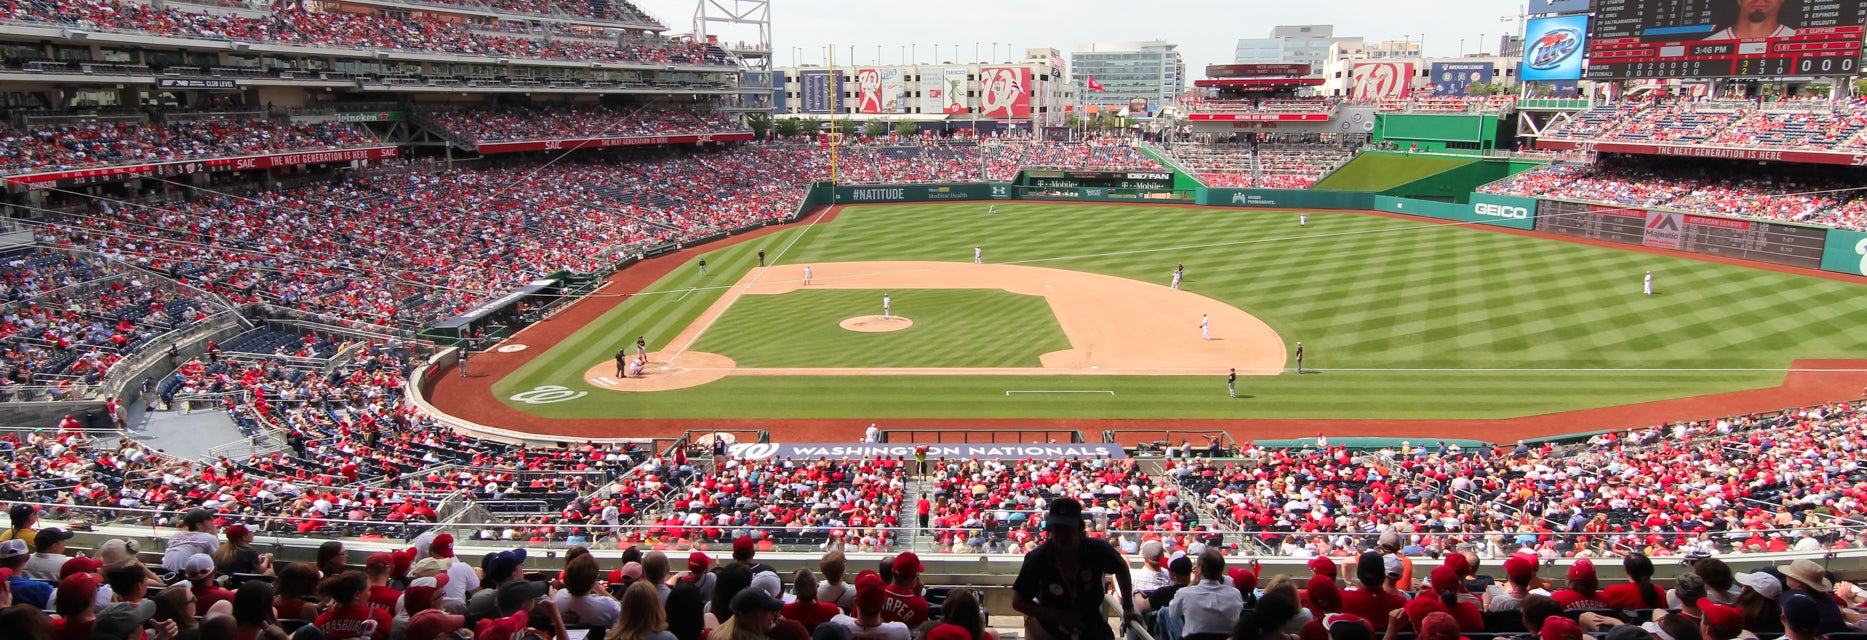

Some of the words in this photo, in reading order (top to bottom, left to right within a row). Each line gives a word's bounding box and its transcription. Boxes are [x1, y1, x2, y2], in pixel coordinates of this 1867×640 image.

[1534, 38, 1576, 65] Lite
[1802, 60, 1811, 71] 0
[1822, 59, 1831, 71] 0
[1842, 59, 1852, 70] 0
[545, 141, 562, 150] SAIC
[1574, 143, 1596, 151] SAIC
[1674, 147, 1693, 155] NEXT
[1695, 148, 1744, 158] GENERATION
[1759, 151, 1782, 160] HERE
[237, 159, 255, 168] SAIC
[270, 156, 283, 166] THE
[285, 155, 300, 165] NEXT
[302, 152, 342, 163] GENERATION
[352, 150, 368, 159] HERE
[381, 148, 396, 157] SAIC
[29, 180, 56, 190] JOHNSON
[178, 165, 183, 173] 3
[198, 164, 203, 172] 2
[853, 188, 904, 200] #NATITUDE
[1474, 203, 1527, 219] GEICO
[1690, 217, 1718, 225] AMERICAN
[1720, 220, 1742, 228] LEAGUE
[1646, 230, 1678, 240] Majestic
[969, 447, 1110, 456] NATIONALS
